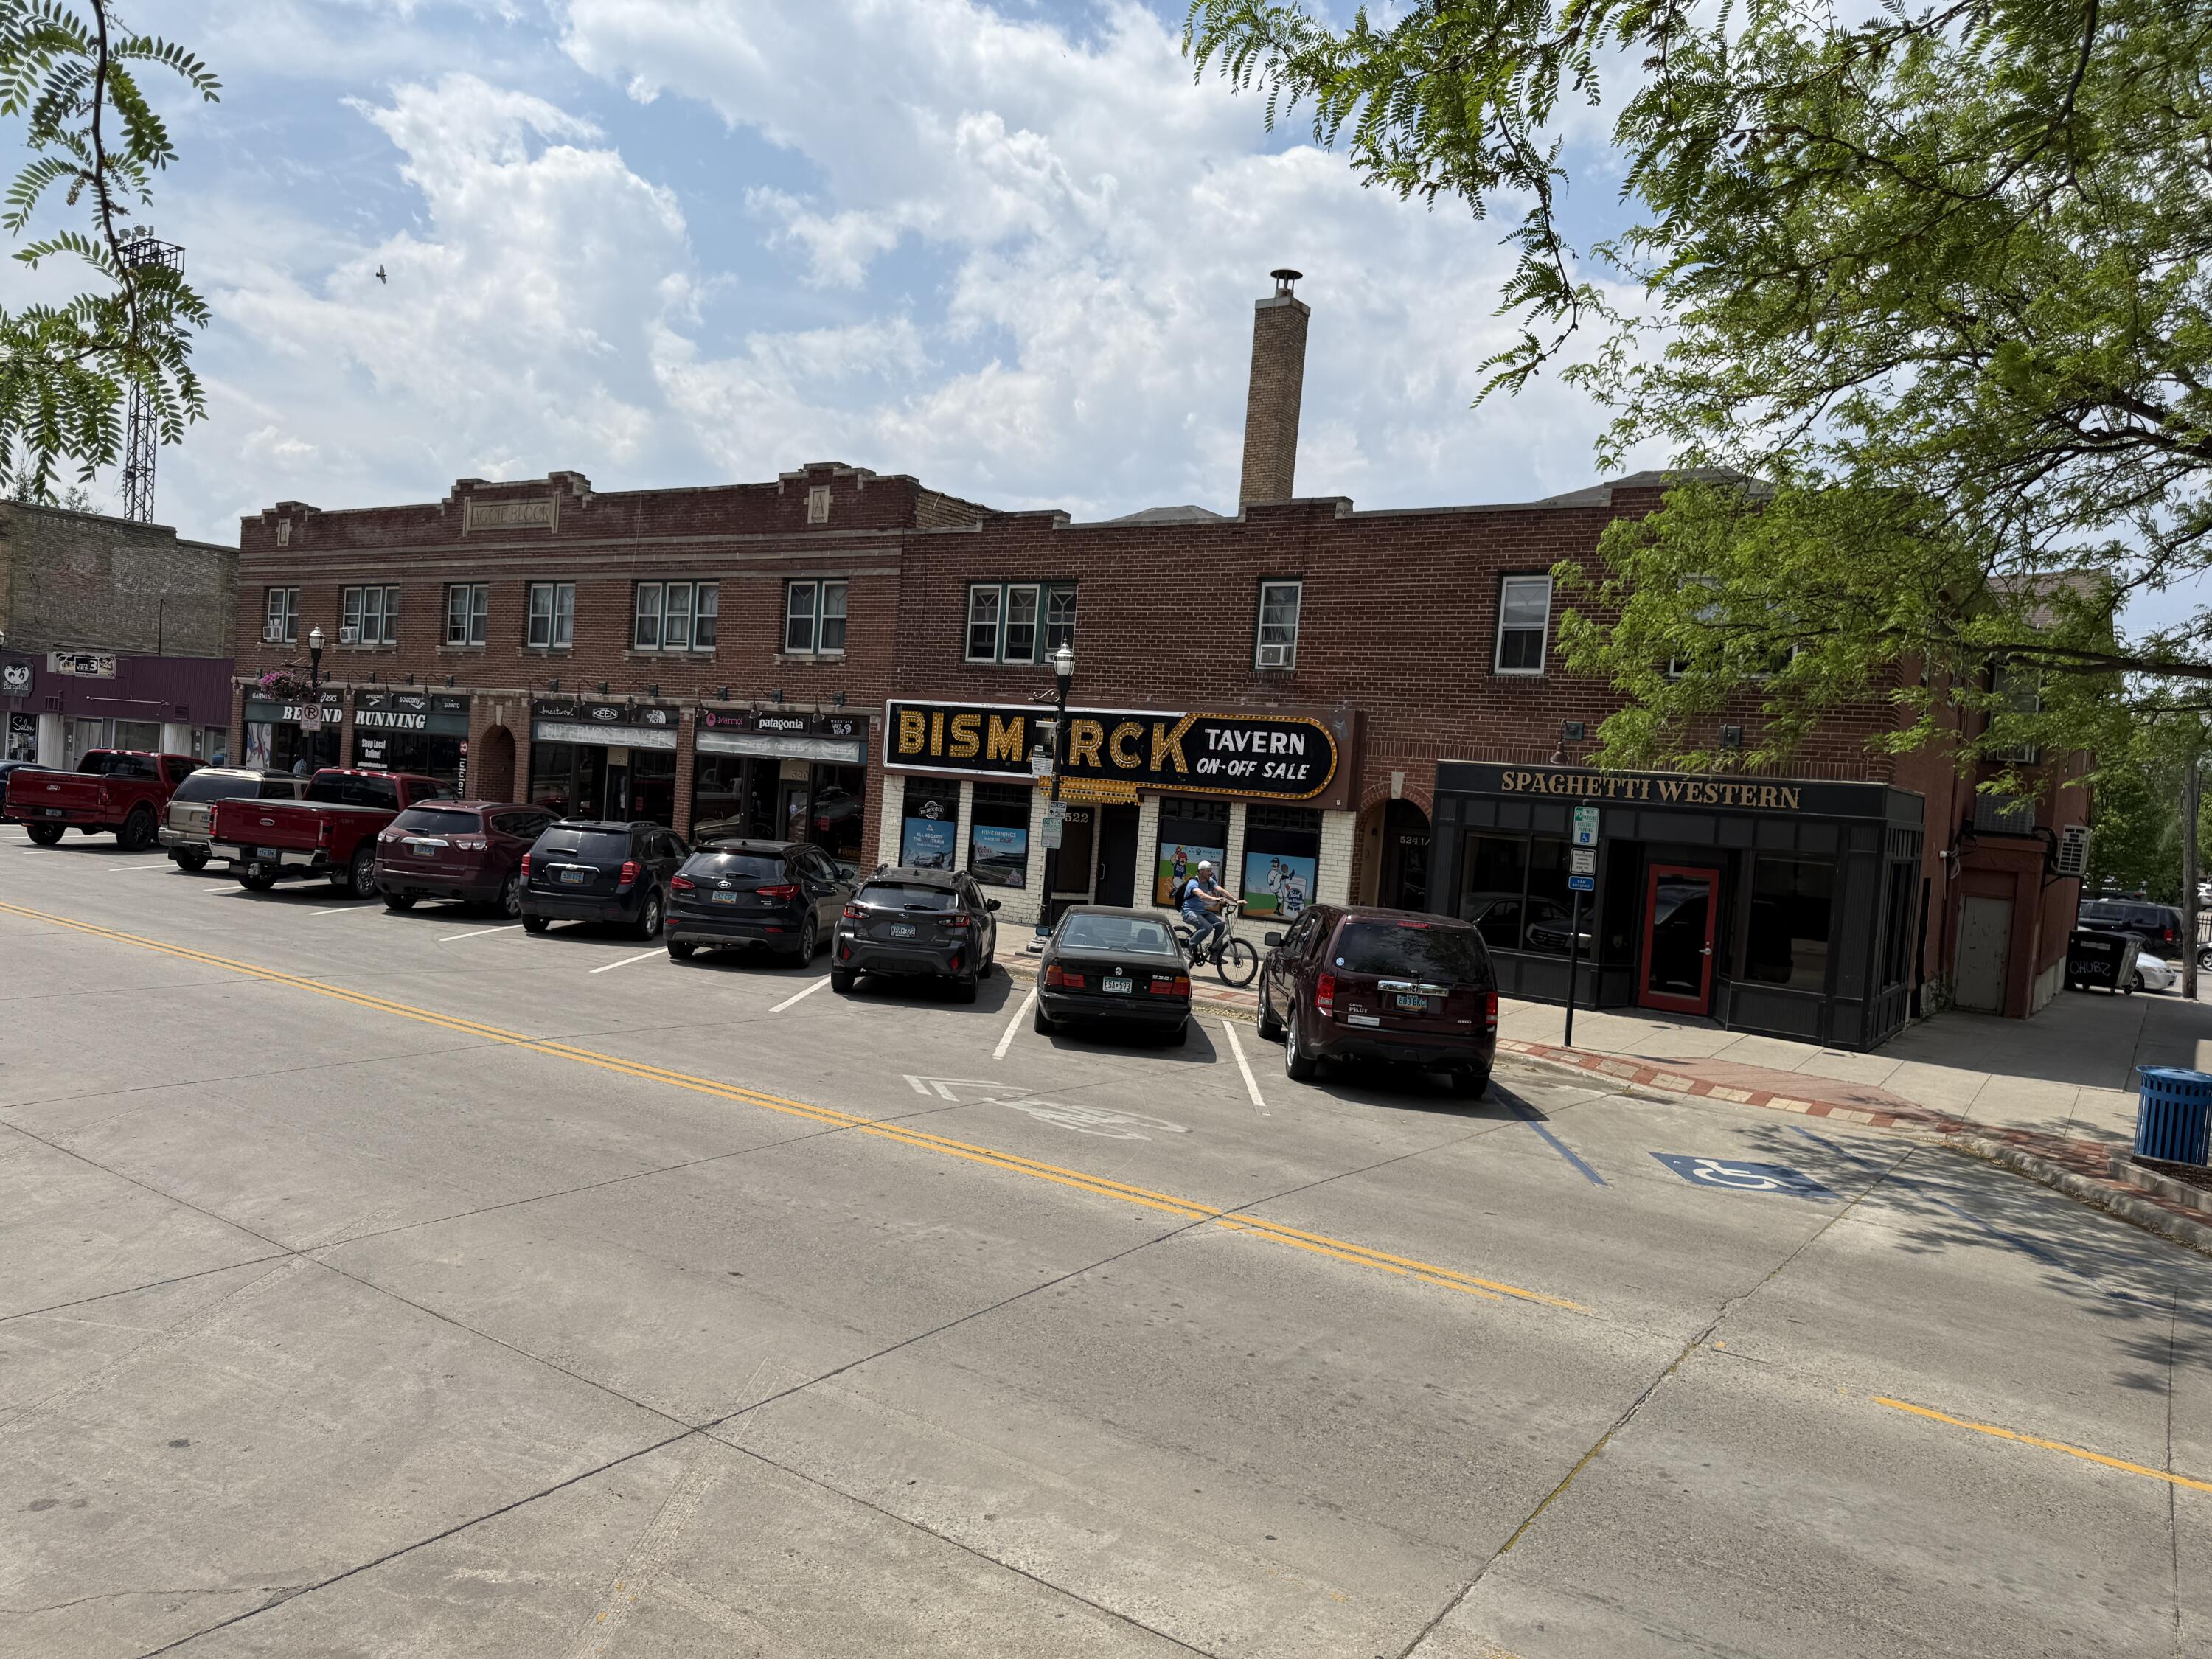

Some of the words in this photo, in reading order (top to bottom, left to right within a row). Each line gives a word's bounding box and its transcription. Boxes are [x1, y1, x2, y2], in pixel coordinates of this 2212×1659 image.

[813, 493, 824, 515] A
[473, 507, 507, 524] AGGIE
[510, 505, 549, 521] BLOCK
[89, 660, 97, 670] 3
[13, 716, 35, 731] Salon
[282, 706, 343, 723] BEND
[355, 710, 426, 729] RUNNING
[759, 717, 804, 730] patagonia
[899, 709, 1196, 774] BISMRCK
[1205, 728, 1305, 756] TAVERN
[1197, 757, 1258, 776] ON-OFF
[1262, 762, 1310, 779] SALE
[1501, 771, 1651, 800] SPAGHETTI
[1657, 779, 1802, 809] WESTERN
[1065, 812, 1089, 824] 522
[1399, 835, 1418, 845] 524
[2070, 961, 2110, 977] CHUBZ
[1399, 997, 1411, 1005] 803
